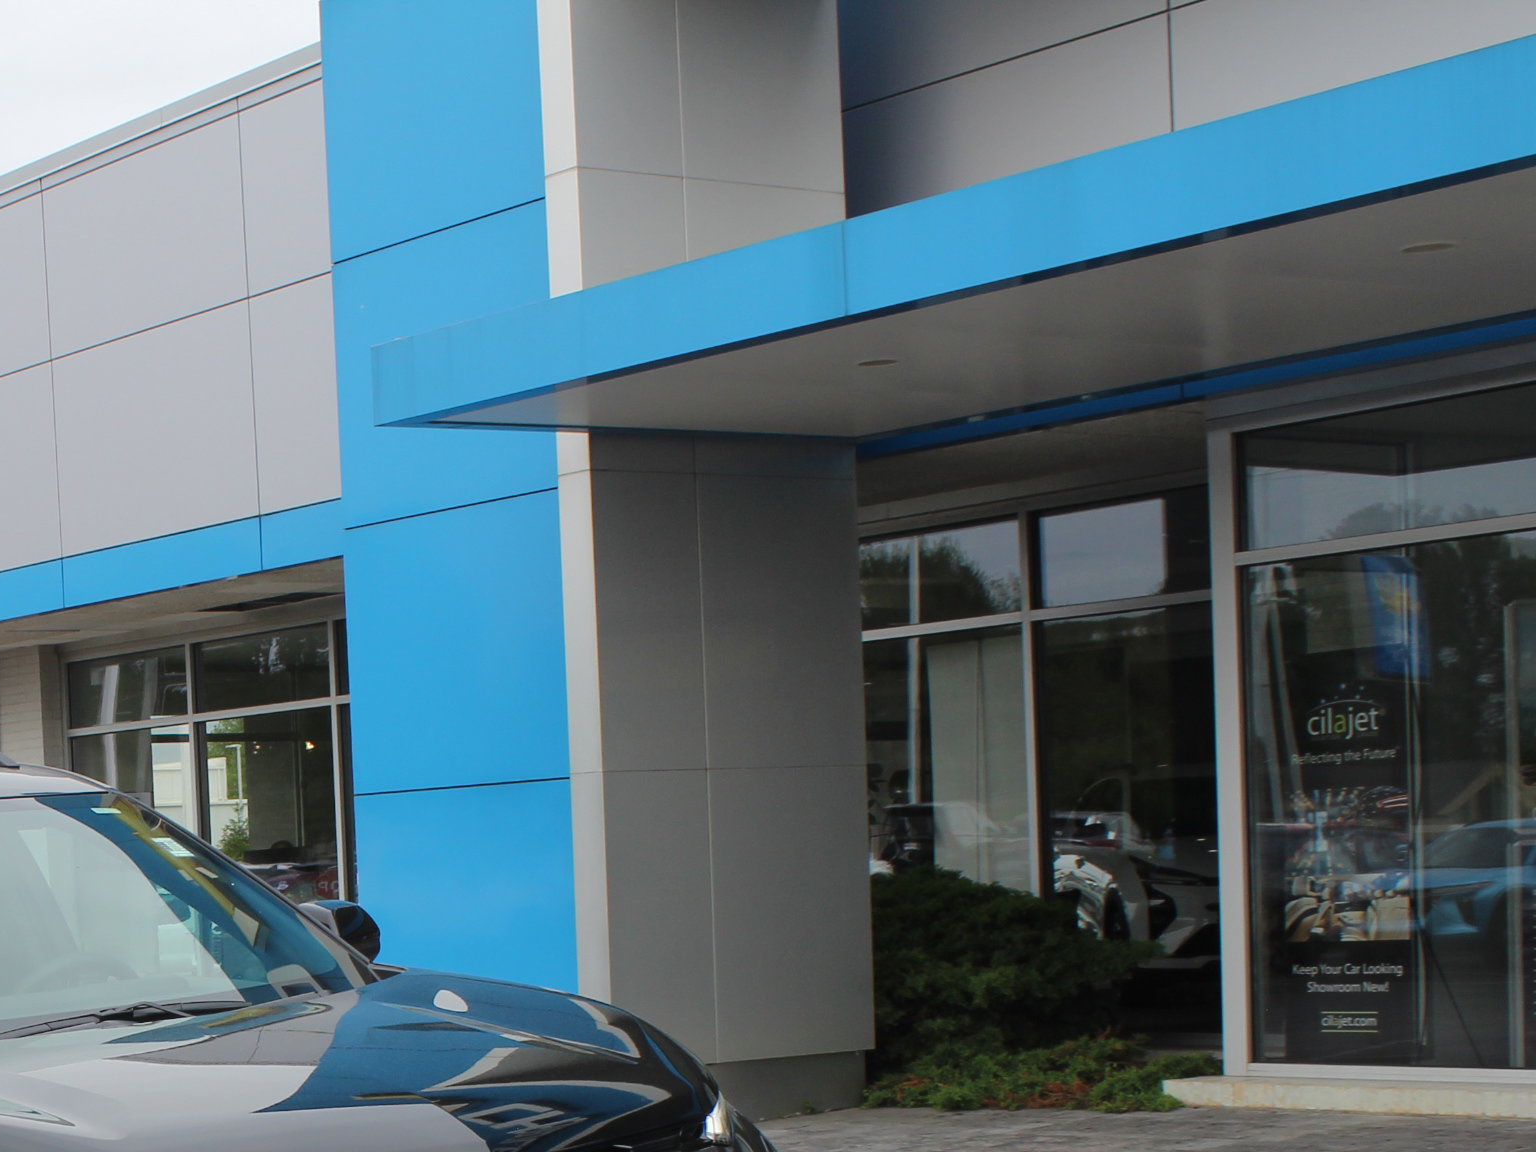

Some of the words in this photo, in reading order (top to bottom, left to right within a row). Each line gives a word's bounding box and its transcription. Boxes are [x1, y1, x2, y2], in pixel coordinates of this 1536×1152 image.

[1306, 706, 1380, 740] cilajet
[1290, 752, 1342, 765] Reflecting
[1344, 750, 1361, 761] the
[1363, 748, 1396, 760] Future
[1292, 964, 1319, 977] Keep
[1319, 964, 1343, 975] Your
[1344, 963, 1361, 975] Car
[1363, 963, 1404, 977] Looking
[1306, 981, 1361, 992] Showroom
[1362, 981, 1390, 992] New!
[1321, 1015, 1378, 1029] cilajet.com
